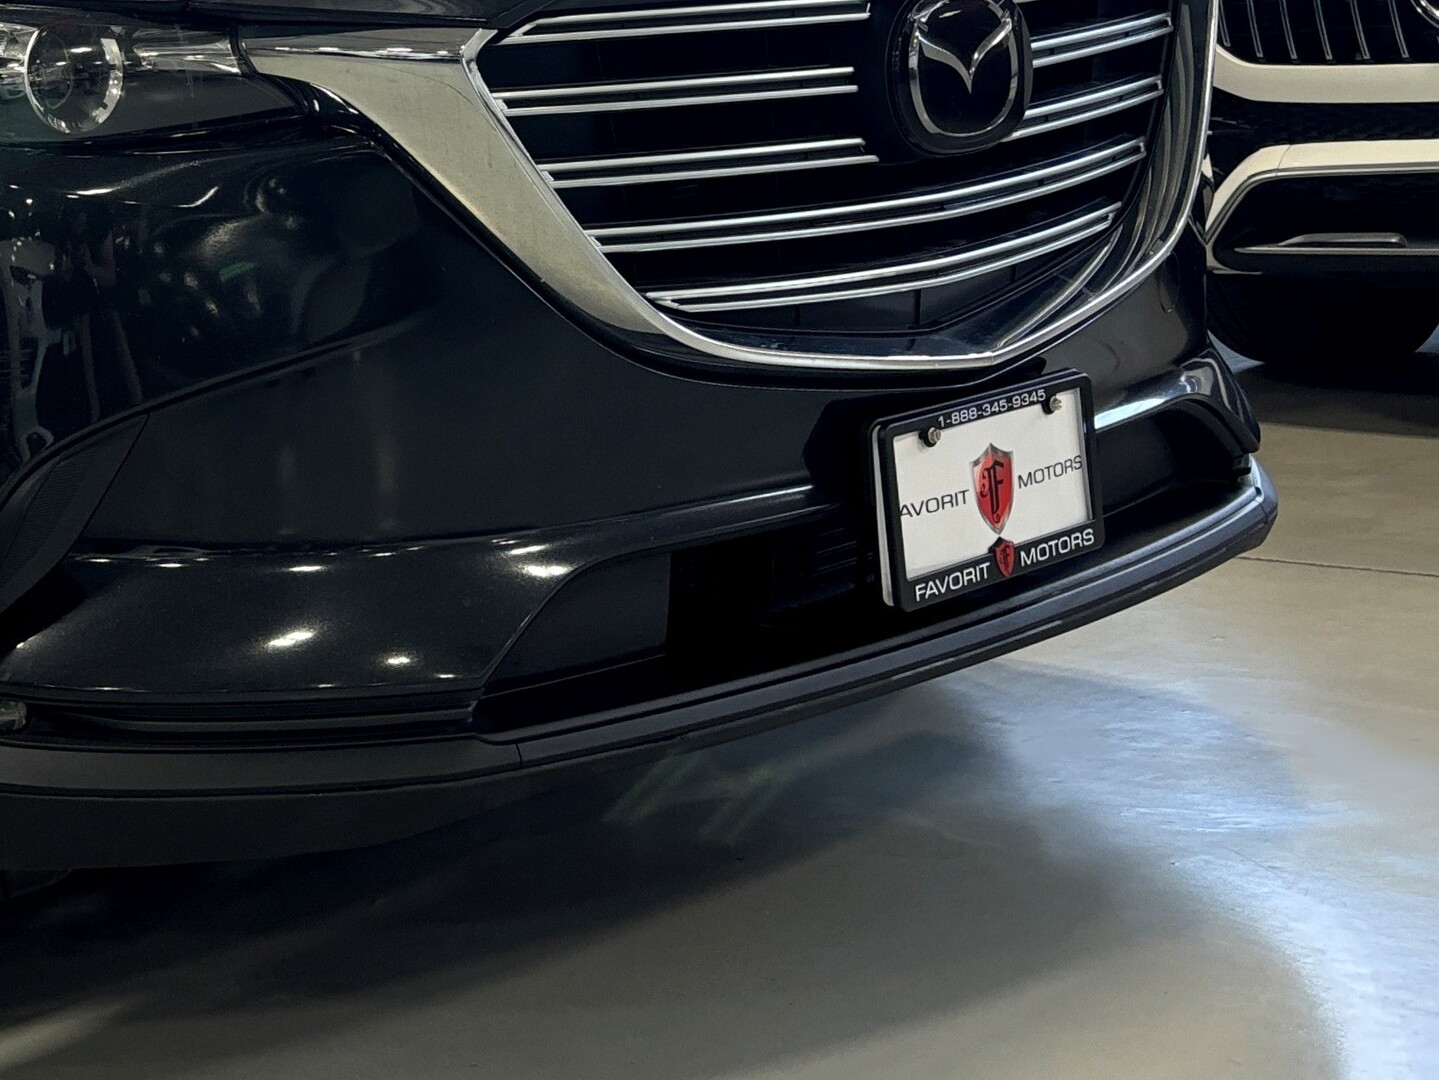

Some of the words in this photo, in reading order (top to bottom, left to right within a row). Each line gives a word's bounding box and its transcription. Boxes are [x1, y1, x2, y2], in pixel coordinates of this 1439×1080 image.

[937, 388, 1047, 428] 1-888-345-9345
[1017, 454, 1083, 490] MOTORS
[915, 561, 991, 602] FAVORIT
[1020, 528, 1095, 568] MOTORS
